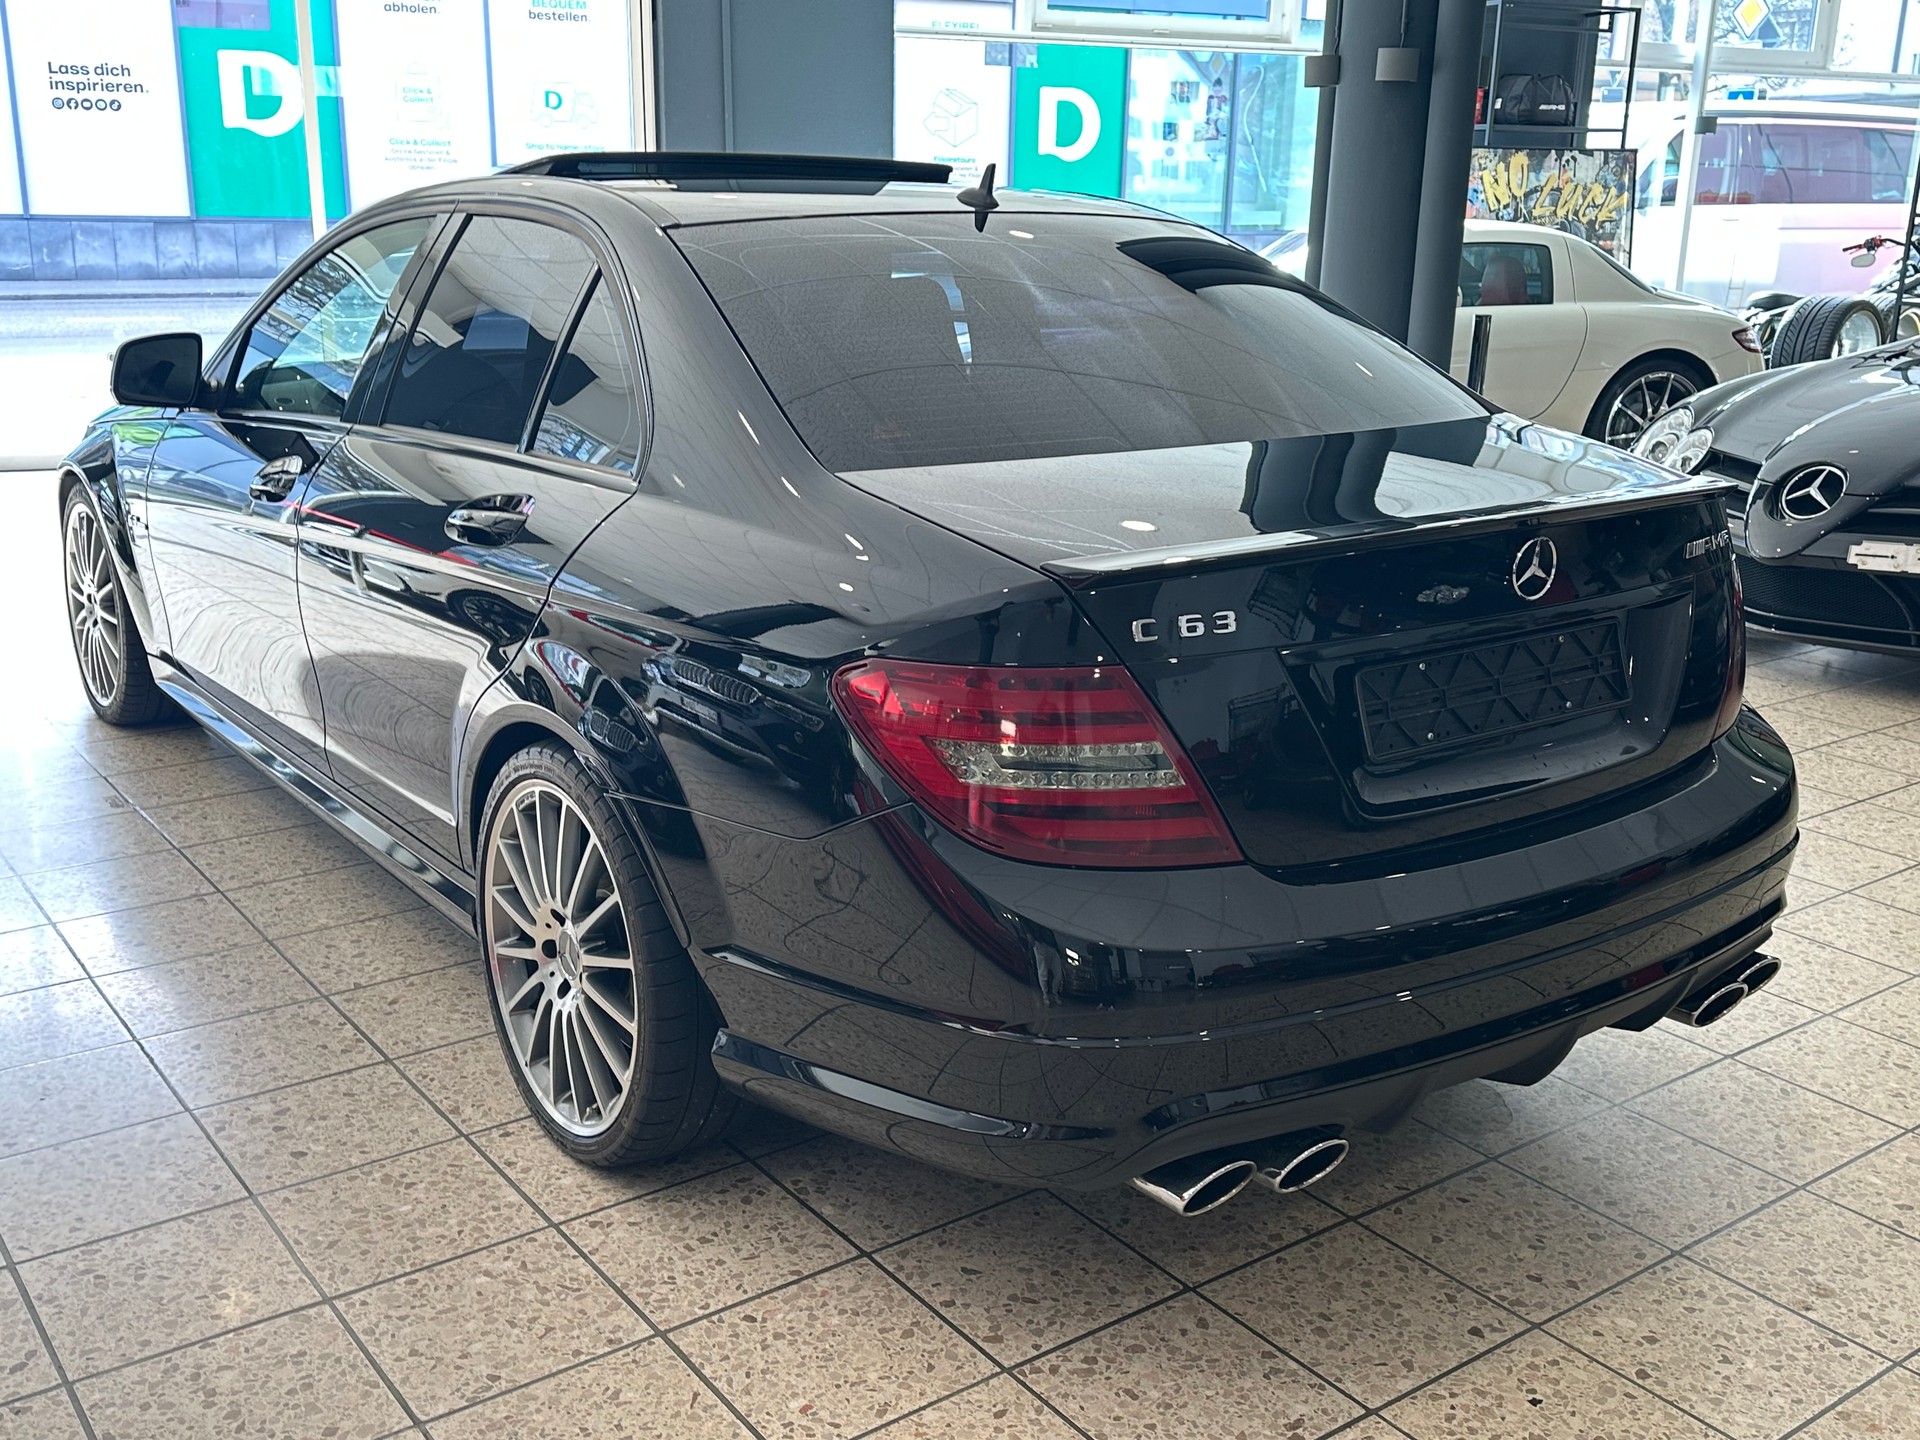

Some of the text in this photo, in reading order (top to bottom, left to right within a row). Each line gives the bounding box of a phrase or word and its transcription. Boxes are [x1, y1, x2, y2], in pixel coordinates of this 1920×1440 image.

[532, 0, 587, 9] BEQUEM
[48, 62, 131, 77] Lass dich
[49, 77, 149, 94] inspirieren.
[217, 49, 304, 137] D
[544, 91, 563, 110] D
[1037, 86, 1101, 162] D
[1482, 151, 1629, 228] NO LUCK
[1132, 610, 1237, 642] C 63
